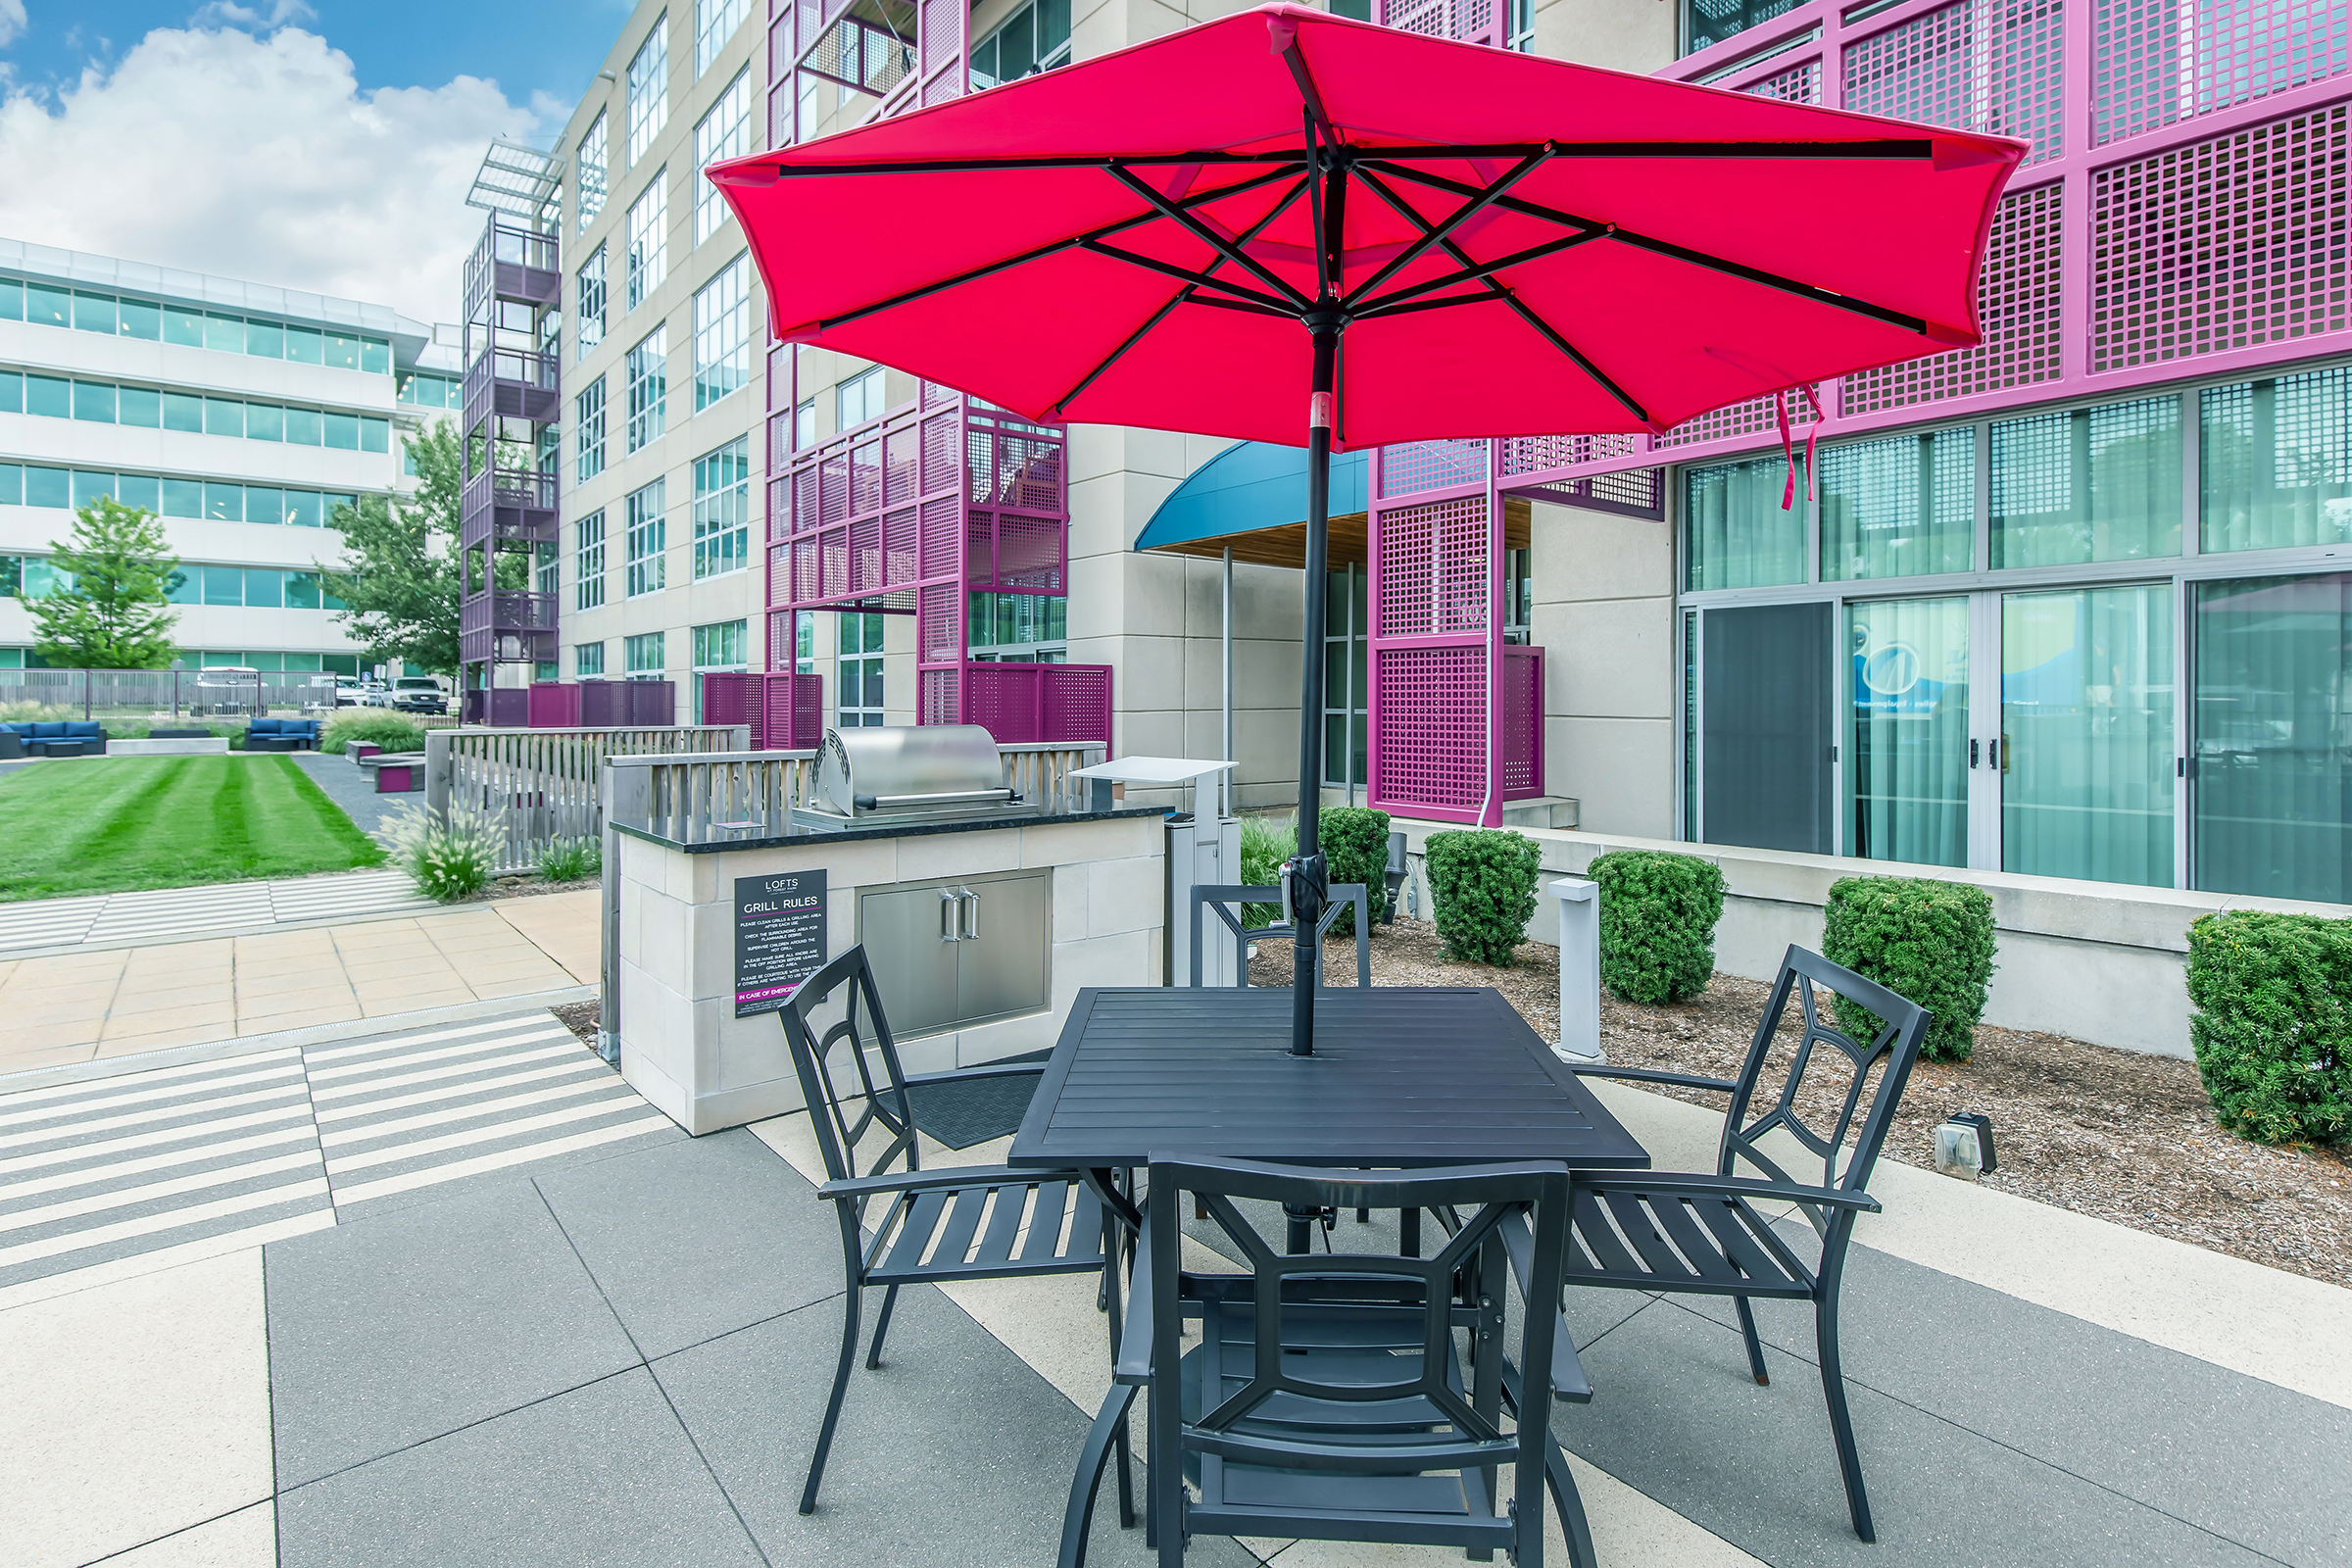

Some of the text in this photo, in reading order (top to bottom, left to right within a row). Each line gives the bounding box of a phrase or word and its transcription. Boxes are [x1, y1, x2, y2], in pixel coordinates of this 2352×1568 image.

[765, 878, 799, 890] LOFTS
[744, 896, 818, 913] GRILL RULES
[770, 985, 797, 995] EMERGEN
